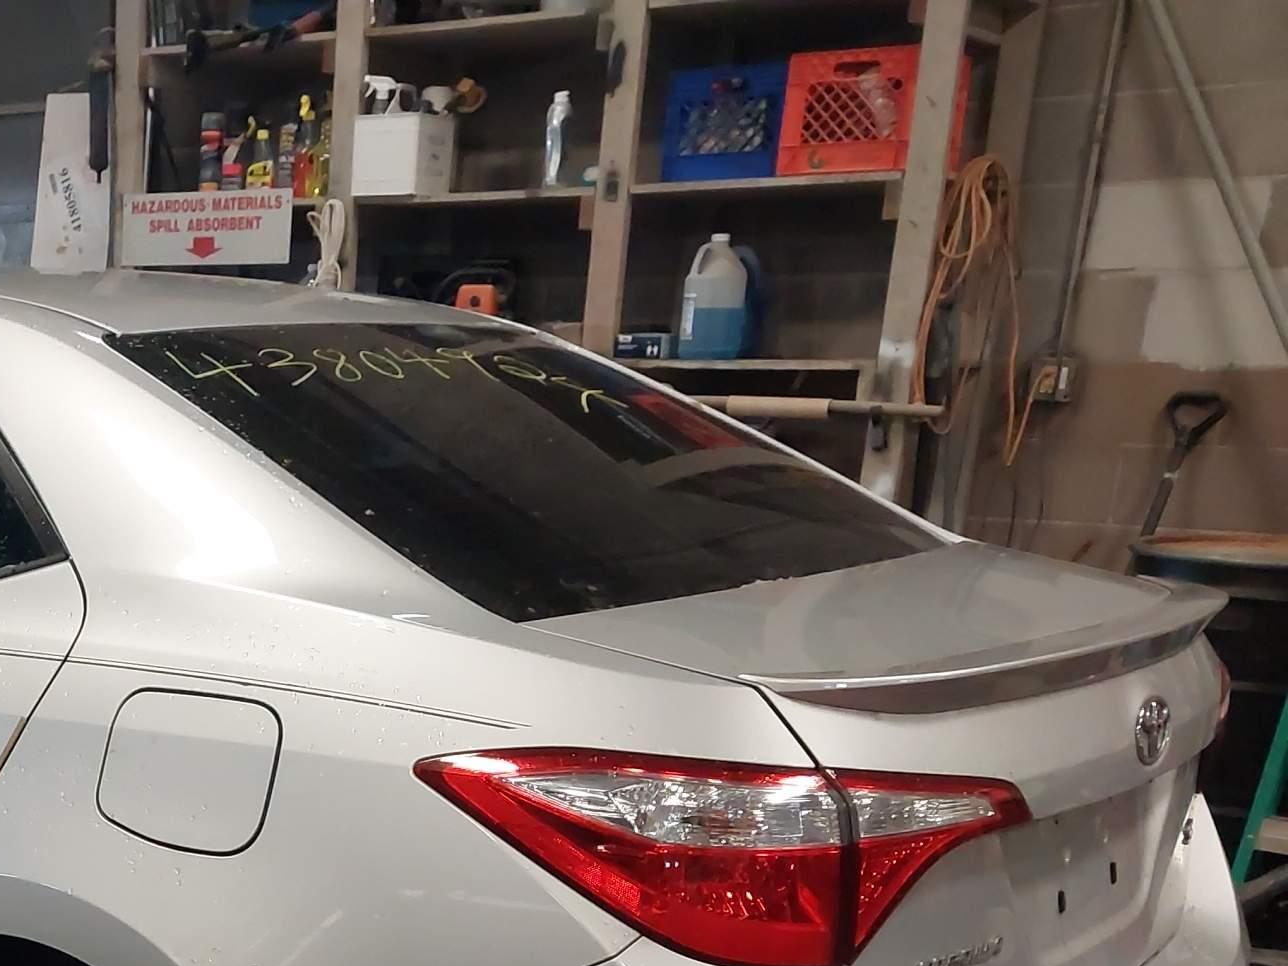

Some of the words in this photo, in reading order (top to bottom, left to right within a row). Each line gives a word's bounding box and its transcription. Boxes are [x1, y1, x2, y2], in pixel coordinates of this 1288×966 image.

[131, 197, 206, 215] HAZARDOUS
[212, 194, 283, 212] MATERIALS
[149, 219, 180, 233] SPILL
[187, 216, 262, 232] ABSORBENT
